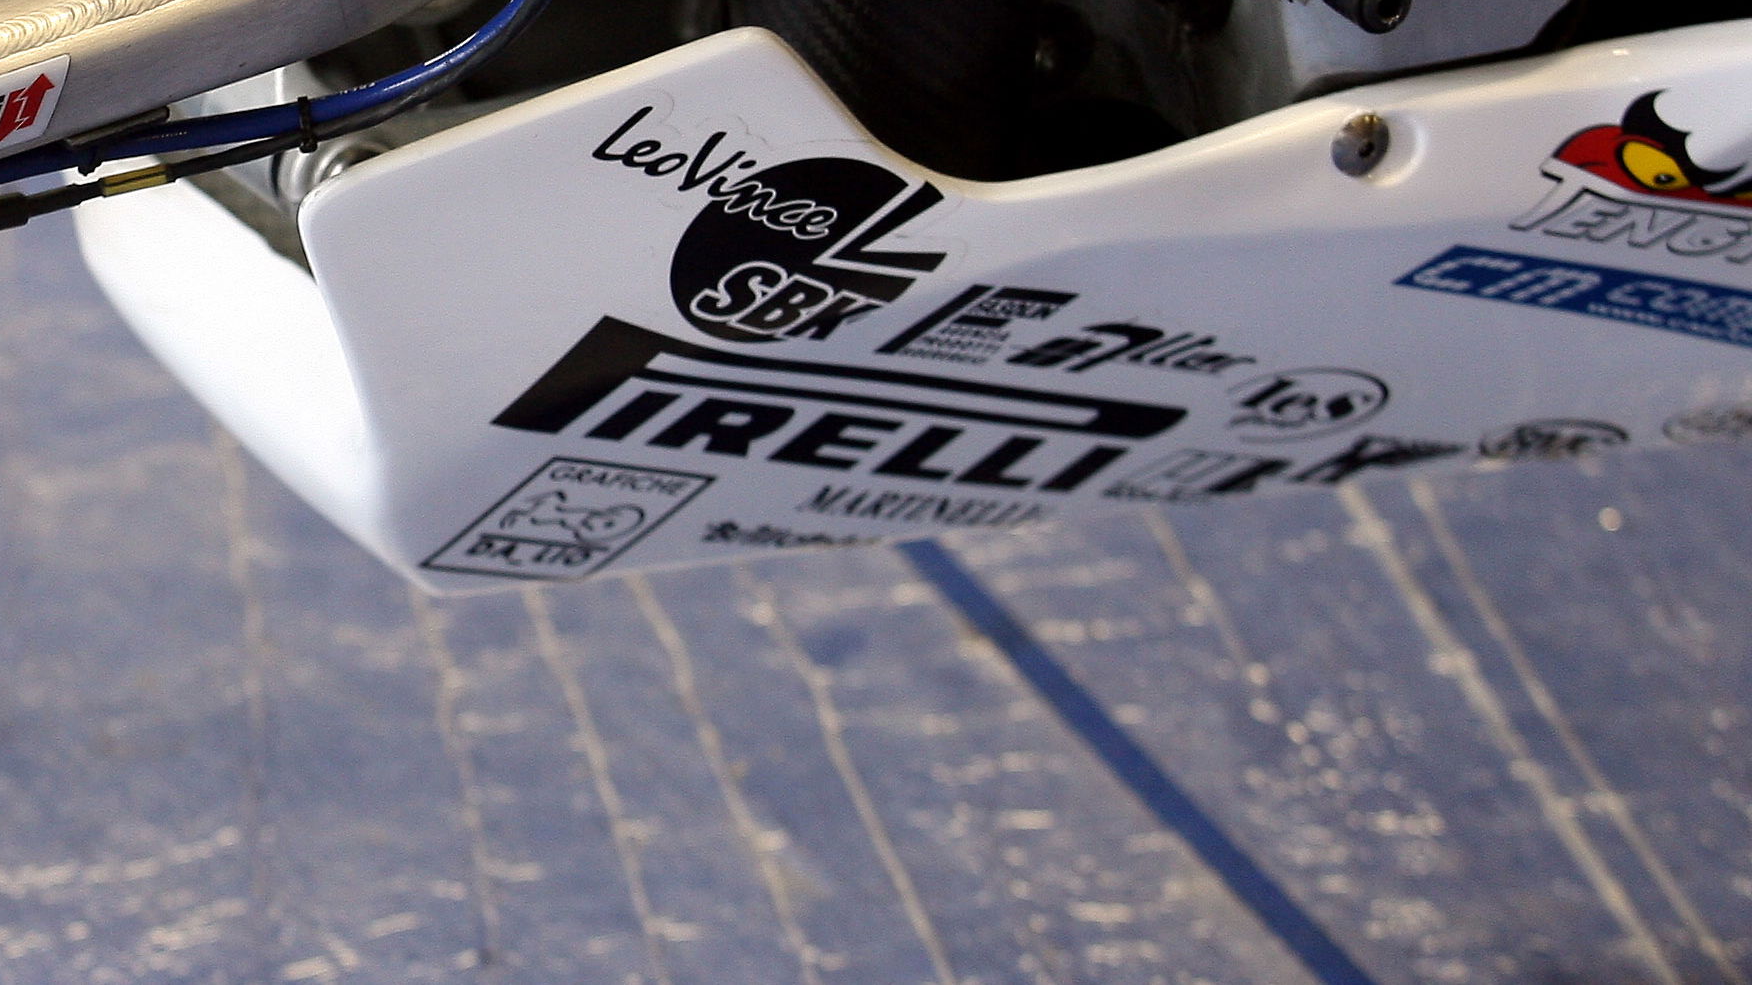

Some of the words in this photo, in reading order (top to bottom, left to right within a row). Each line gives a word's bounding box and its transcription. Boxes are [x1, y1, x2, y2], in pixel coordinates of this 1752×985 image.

[592, 105, 838, 240] LeoVince
[690, 261, 889, 341] SBK
[490, 315, 1189, 492] PIRELLI
[549, 465, 691, 496] GRAFICHE
